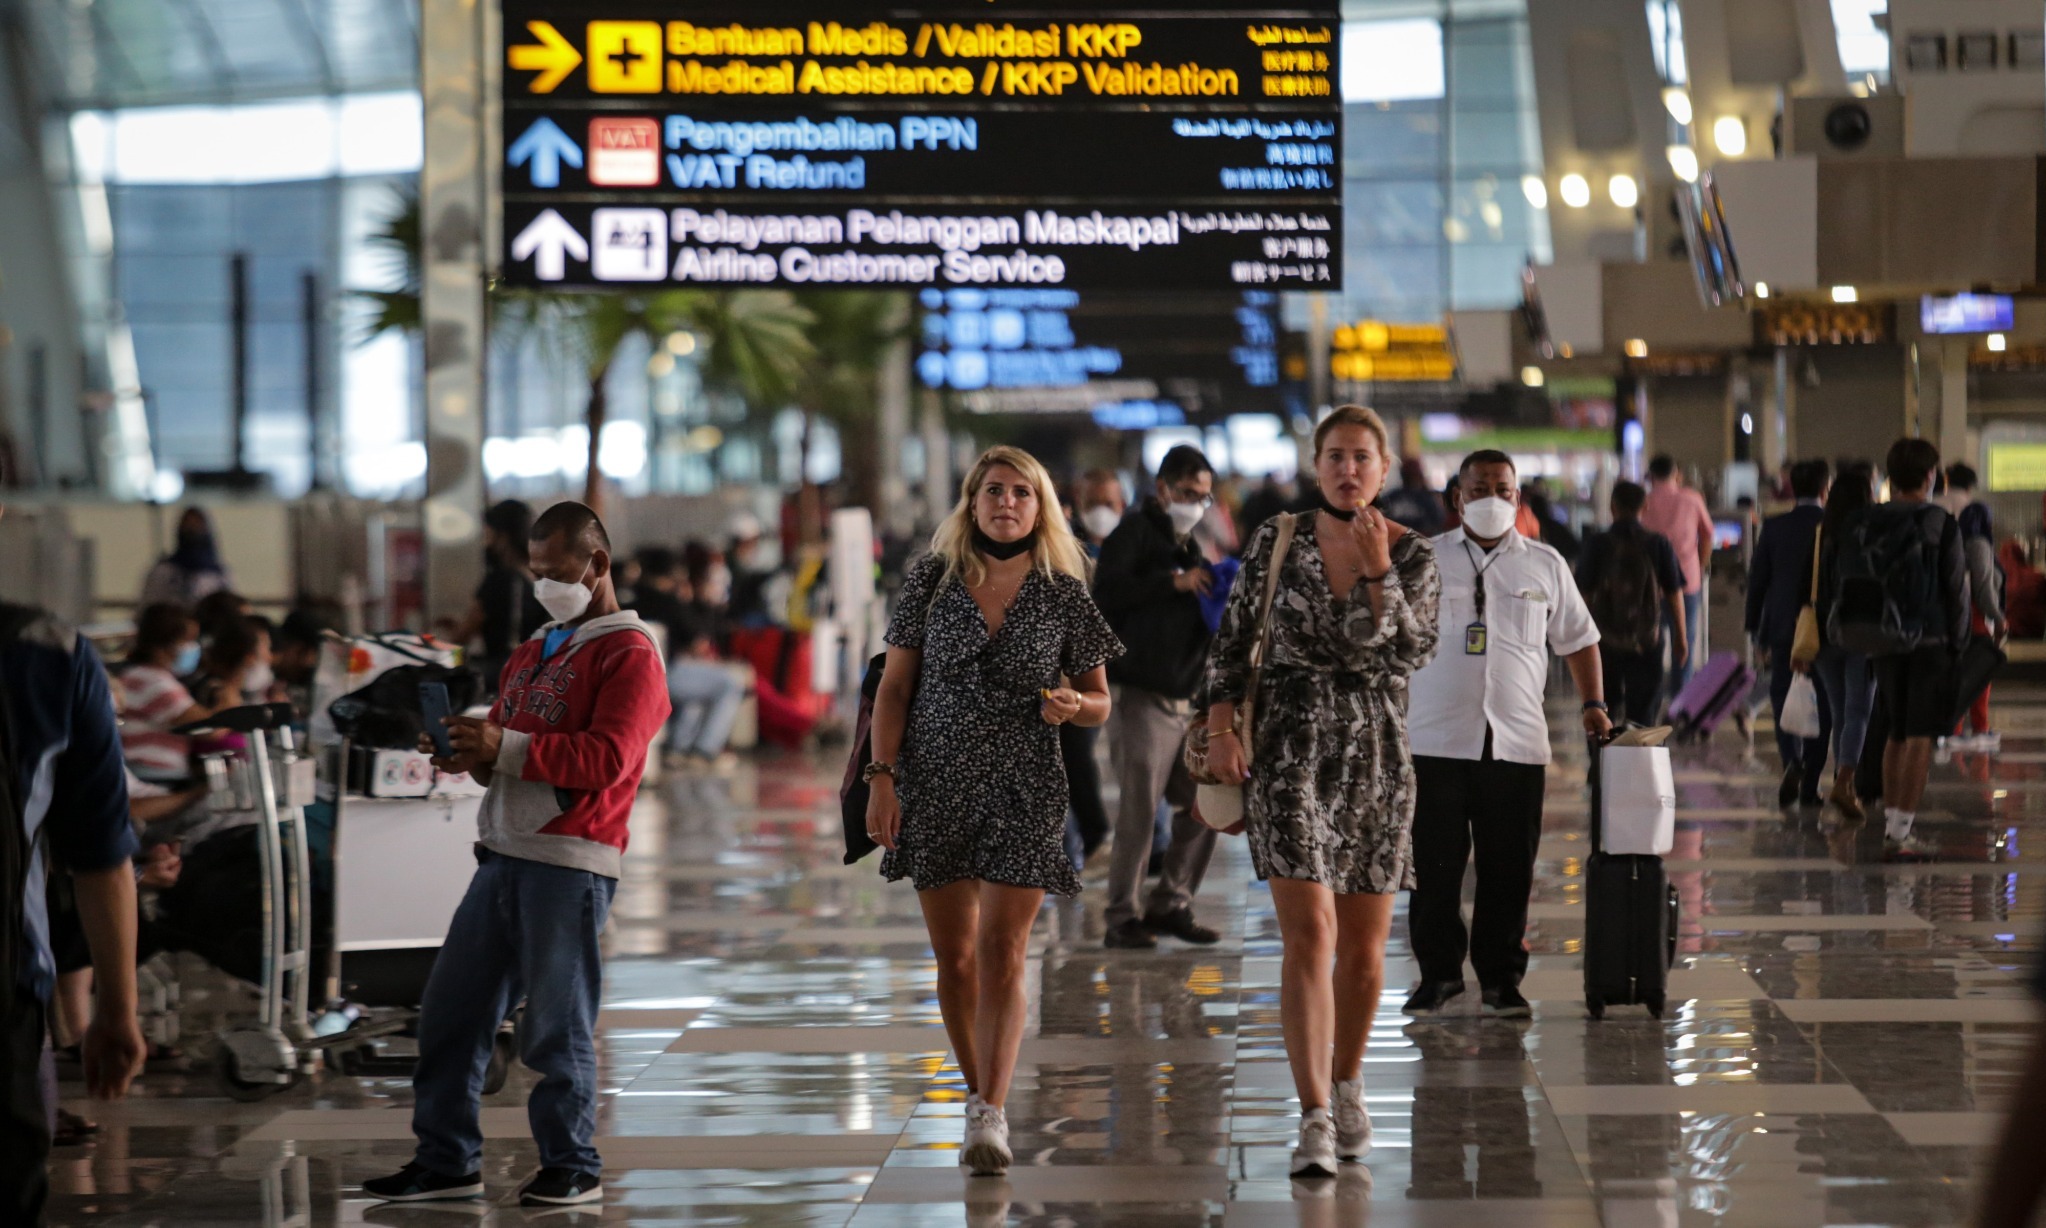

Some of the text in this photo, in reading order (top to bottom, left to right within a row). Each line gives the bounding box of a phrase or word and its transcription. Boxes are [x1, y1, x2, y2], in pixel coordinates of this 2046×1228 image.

[666, 21, 804, 56] Bantuan
[808, 22, 908, 56] Medis
[934, 23, 1060, 57] Validasi
[1067, 23, 1142, 57] KKP
[667, 59, 795, 94] Medical
[798, 59, 974, 94] Assistance
[1002, 61, 1078, 95] KKP
[1081, 61, 1239, 96] Validation
[602, 128, 652, 148] VAT
[665, 115, 978, 157] Pengembalian PPN
[666, 154, 865, 189] VAT Refund
[670, 208, 1179, 252] Pelayanan Pelanggan Maskapai
[671, 246, 1065, 283] Airline Customer Service
